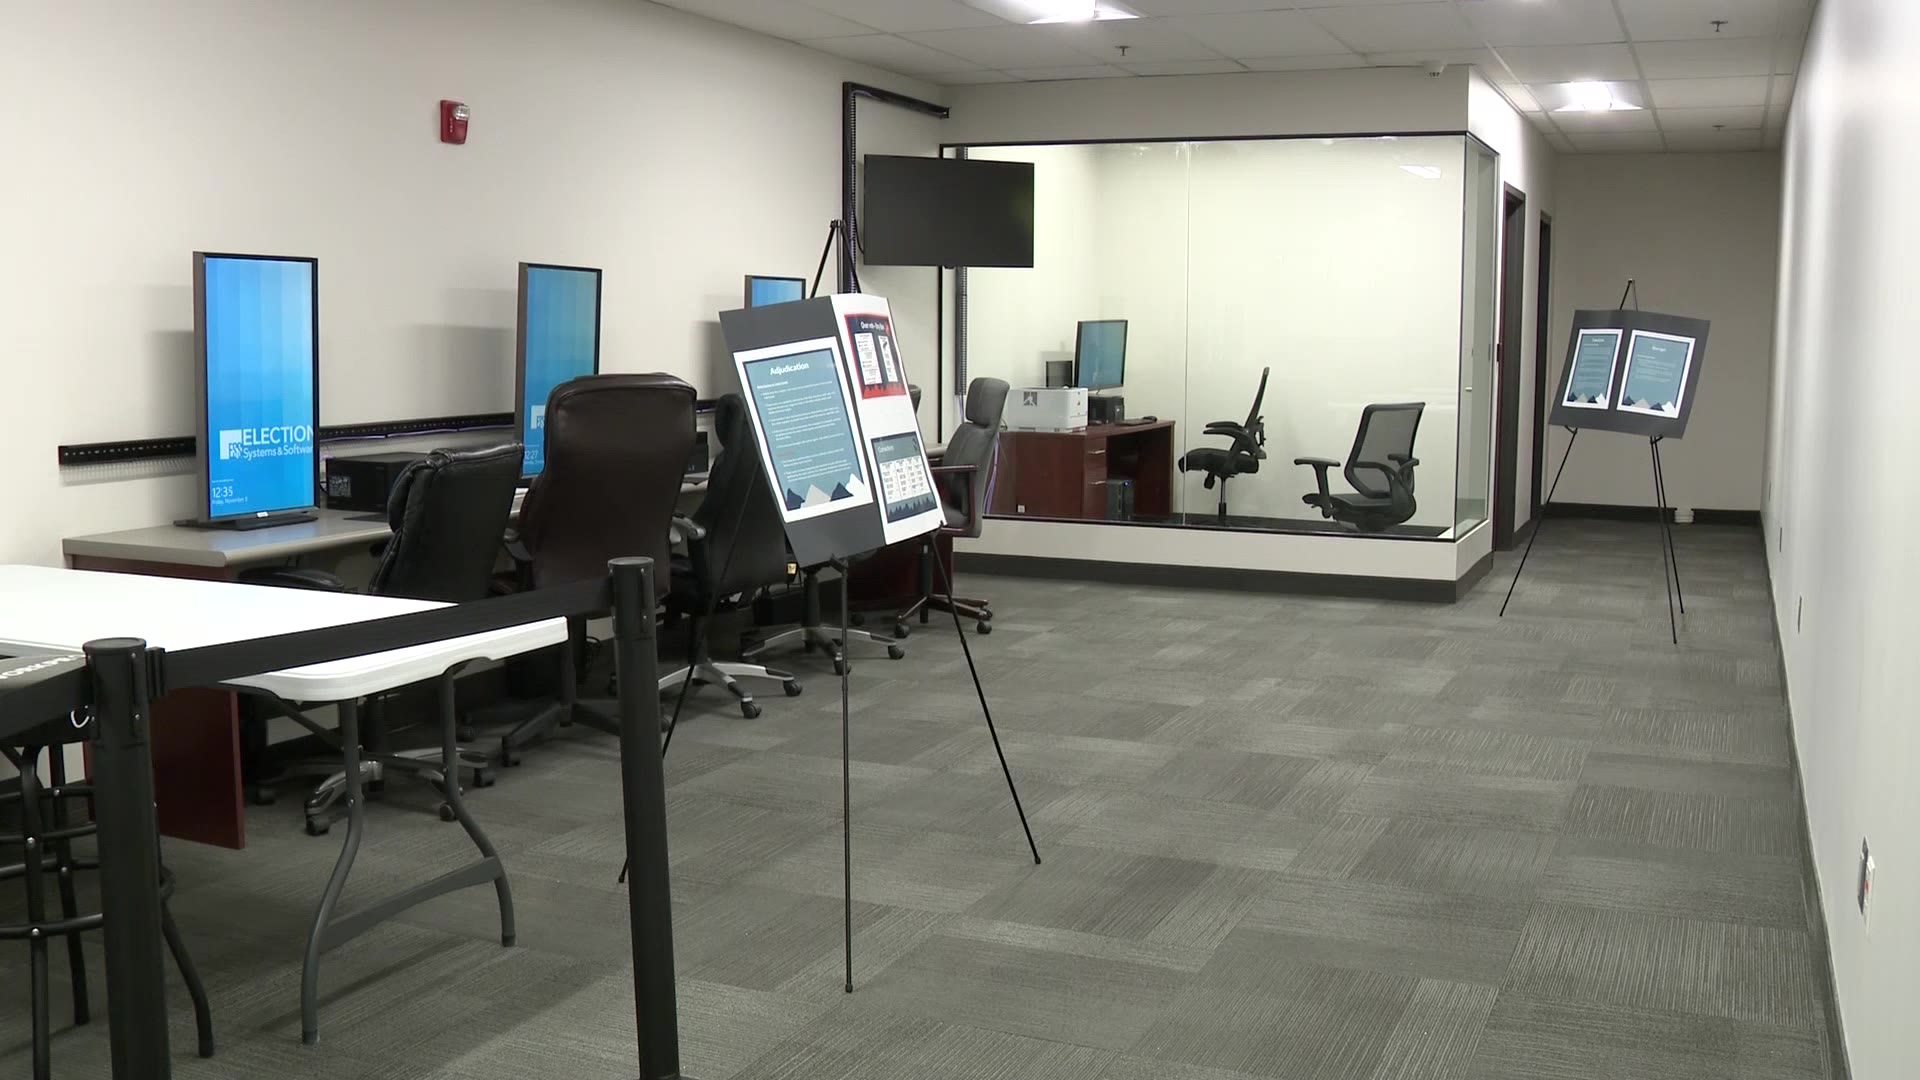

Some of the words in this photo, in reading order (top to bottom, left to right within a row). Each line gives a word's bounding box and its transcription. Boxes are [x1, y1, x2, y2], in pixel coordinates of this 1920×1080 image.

[770, 362, 810, 376] Adjudication
[243, 447, 277, 461] Systems
[277, 447, 283, 456] &
[212, 486, 233, 498] 12:35
